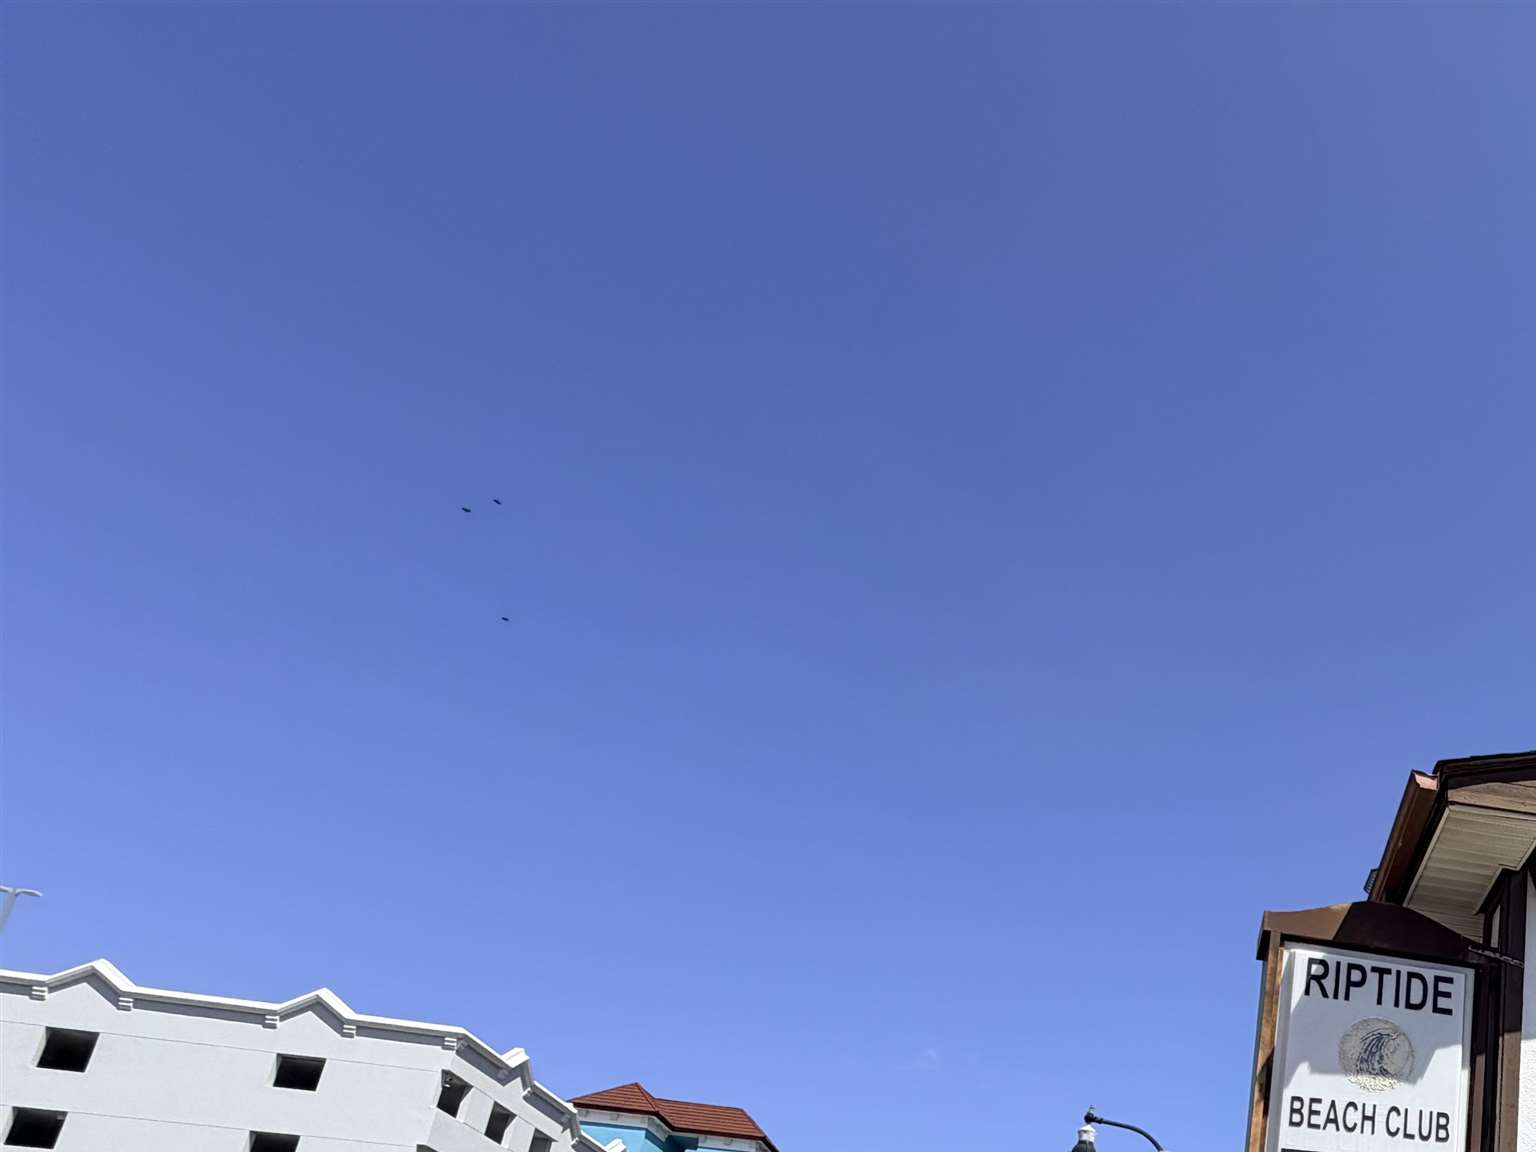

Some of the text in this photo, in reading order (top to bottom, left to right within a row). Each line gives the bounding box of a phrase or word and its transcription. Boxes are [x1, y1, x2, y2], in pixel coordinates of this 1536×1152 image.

[1304, 957, 1455, 1016] RIPTIDE
[1288, 1095, 1450, 1144] BEACH CLUB
